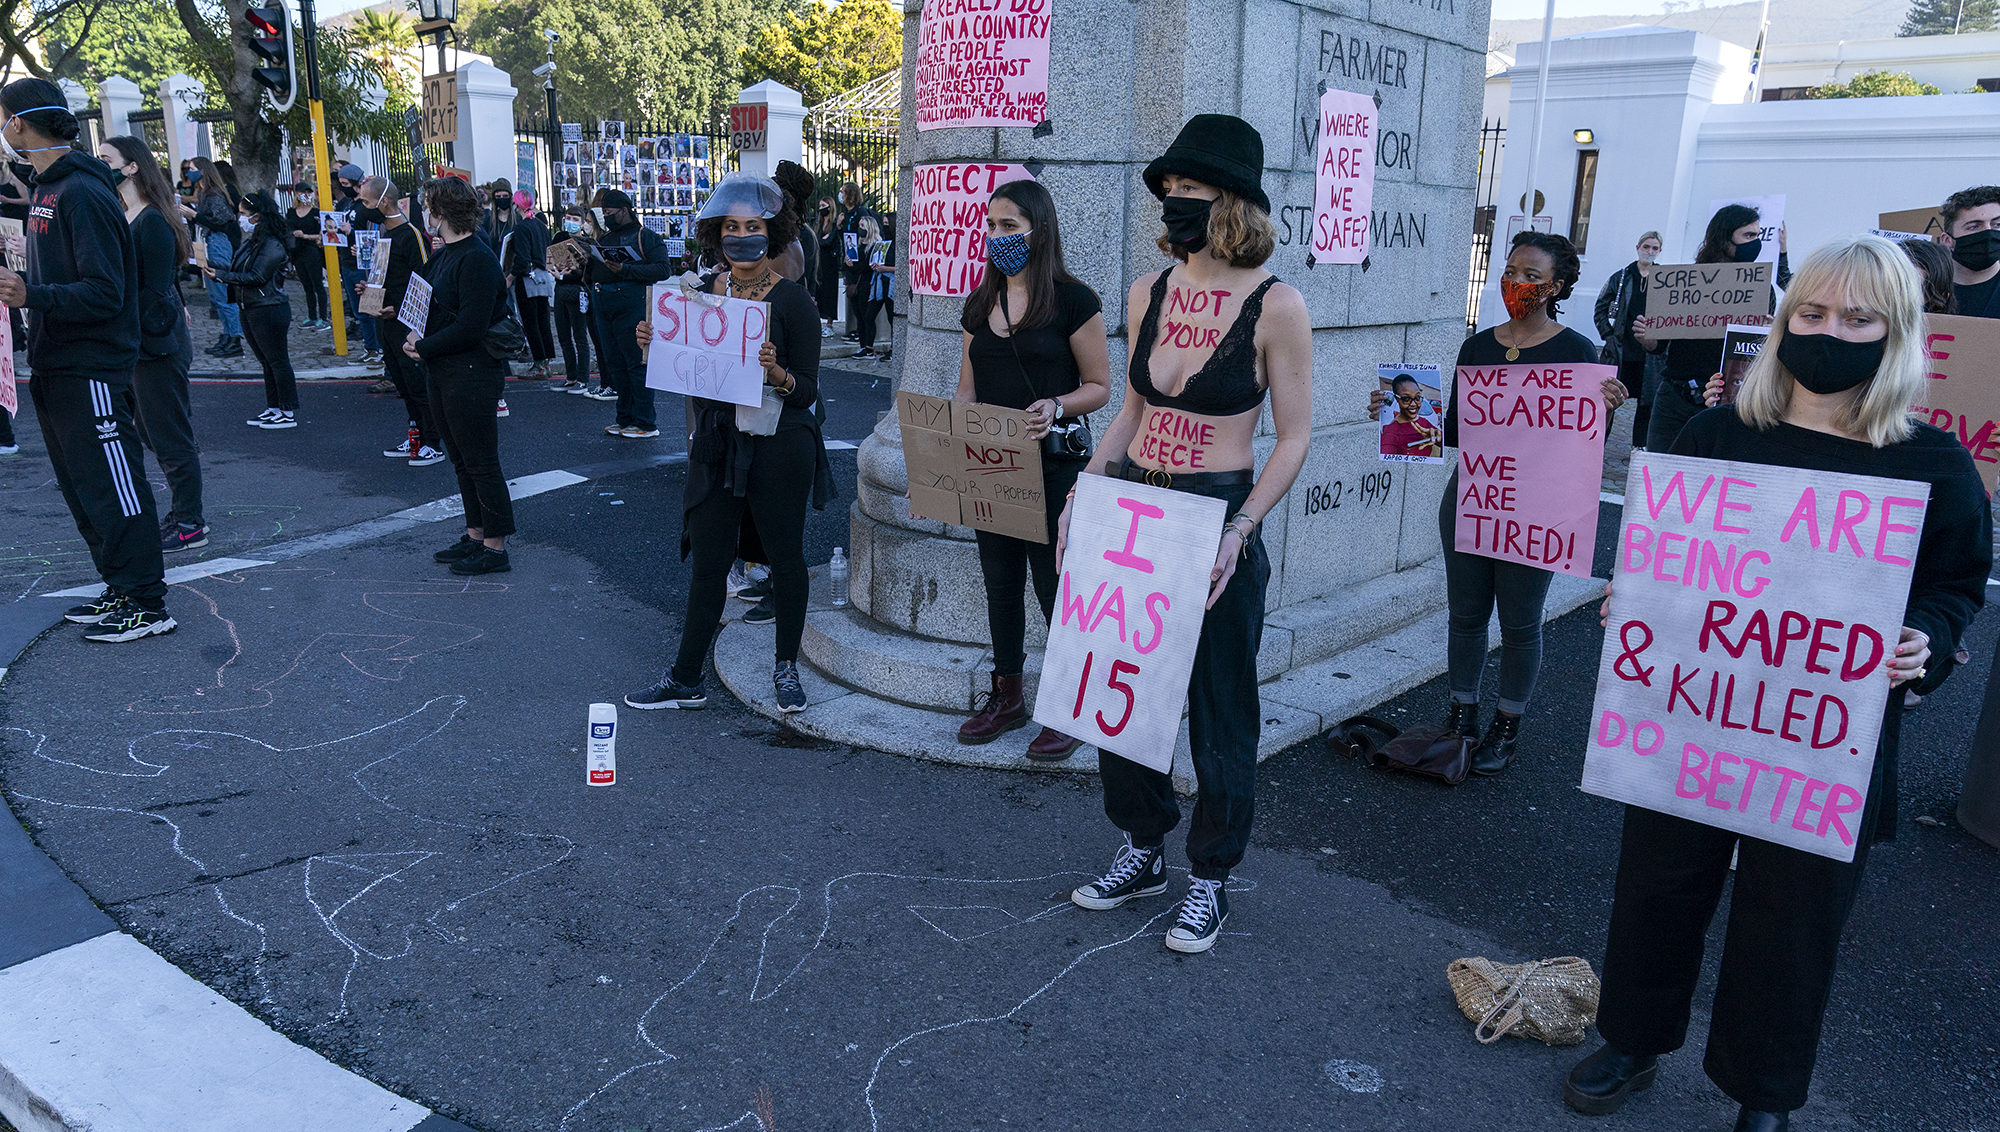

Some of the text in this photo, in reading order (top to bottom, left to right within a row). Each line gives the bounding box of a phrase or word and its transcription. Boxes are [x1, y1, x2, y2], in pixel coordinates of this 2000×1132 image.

[919, 13, 1050, 47] LIVE IN A COUNTRY
[917, 40, 1005, 67] WHERE PEOPLE
[1318, 29, 1407, 89] FARMER
[916, 58, 1031, 88] PROTESTING AGAINST
[940, 77, 1005, 94] ARRESTED
[423, 78, 455, 107] AM I
[940, 94, 962, 106] THAN
[965, 93, 986, 106] THE
[989, 92, 1015, 106] PPL
[423, 106, 458, 139] NEXT?
[731, 105, 767, 131] STOP
[945, 105, 978, 120] COMMIT
[981, 105, 999, 119] THE
[1325, 110, 1369, 138] WHERE
[733, 130, 766, 149] GBV!
[1301, 117, 1411, 170] WIOR
[1322, 147, 1362, 179] ARE
[913, 165, 1008, 199] PROTECT
[911, 200, 946, 227] BLACK
[1331, 185, 1353, 212] WE
[910, 228, 965, 257] PROTECT
[1315, 213, 1368, 252] SAFE?
[909, 257, 984, 294] TRANS LIV
[1653, 266, 1764, 290] SCREW THE
[1169, 287, 1231, 317] NOT
[1668, 289, 1754, 306] BRO-CODE
[657, 291, 766, 368] STOP
[1160, 319, 1220, 349] YOUR
[1733, 341, 1763, 354] MISS
[673, 350, 734, 395] GBV
[1461, 368, 1573, 389] WE ARE
[908, 398, 944, 426] MY
[1464, 390, 1598, 440] SCARED,
[938, 438, 950, 448] IS
[1149, 411, 1216, 447] CRIME
[965, 442, 1020, 467] NOT
[1463, 451, 1517, 481] WE
[927, 469, 1042, 503] YOUR PROPERTY
[1305, 481, 1342, 516] 1862
[1360, 470, 1392, 509] 1919
[1461, 483, 1516, 512] ARE
[974, 501, 993, 523] !!!
[1642, 465, 1925, 567] WE ARE
[1103, 497, 1165, 574] I
[1463, 513, 1575, 570] TIRED!
[1623, 523, 1771, 598] BEING
[1062, 571, 1170, 655] WAS
[1699, 600, 1884, 682] RAPED
[1073, 651, 1140, 737] 15
[1613, 620, 1858, 755] & KILLED.
[1597, 710, 1863, 847] DO BETTER
